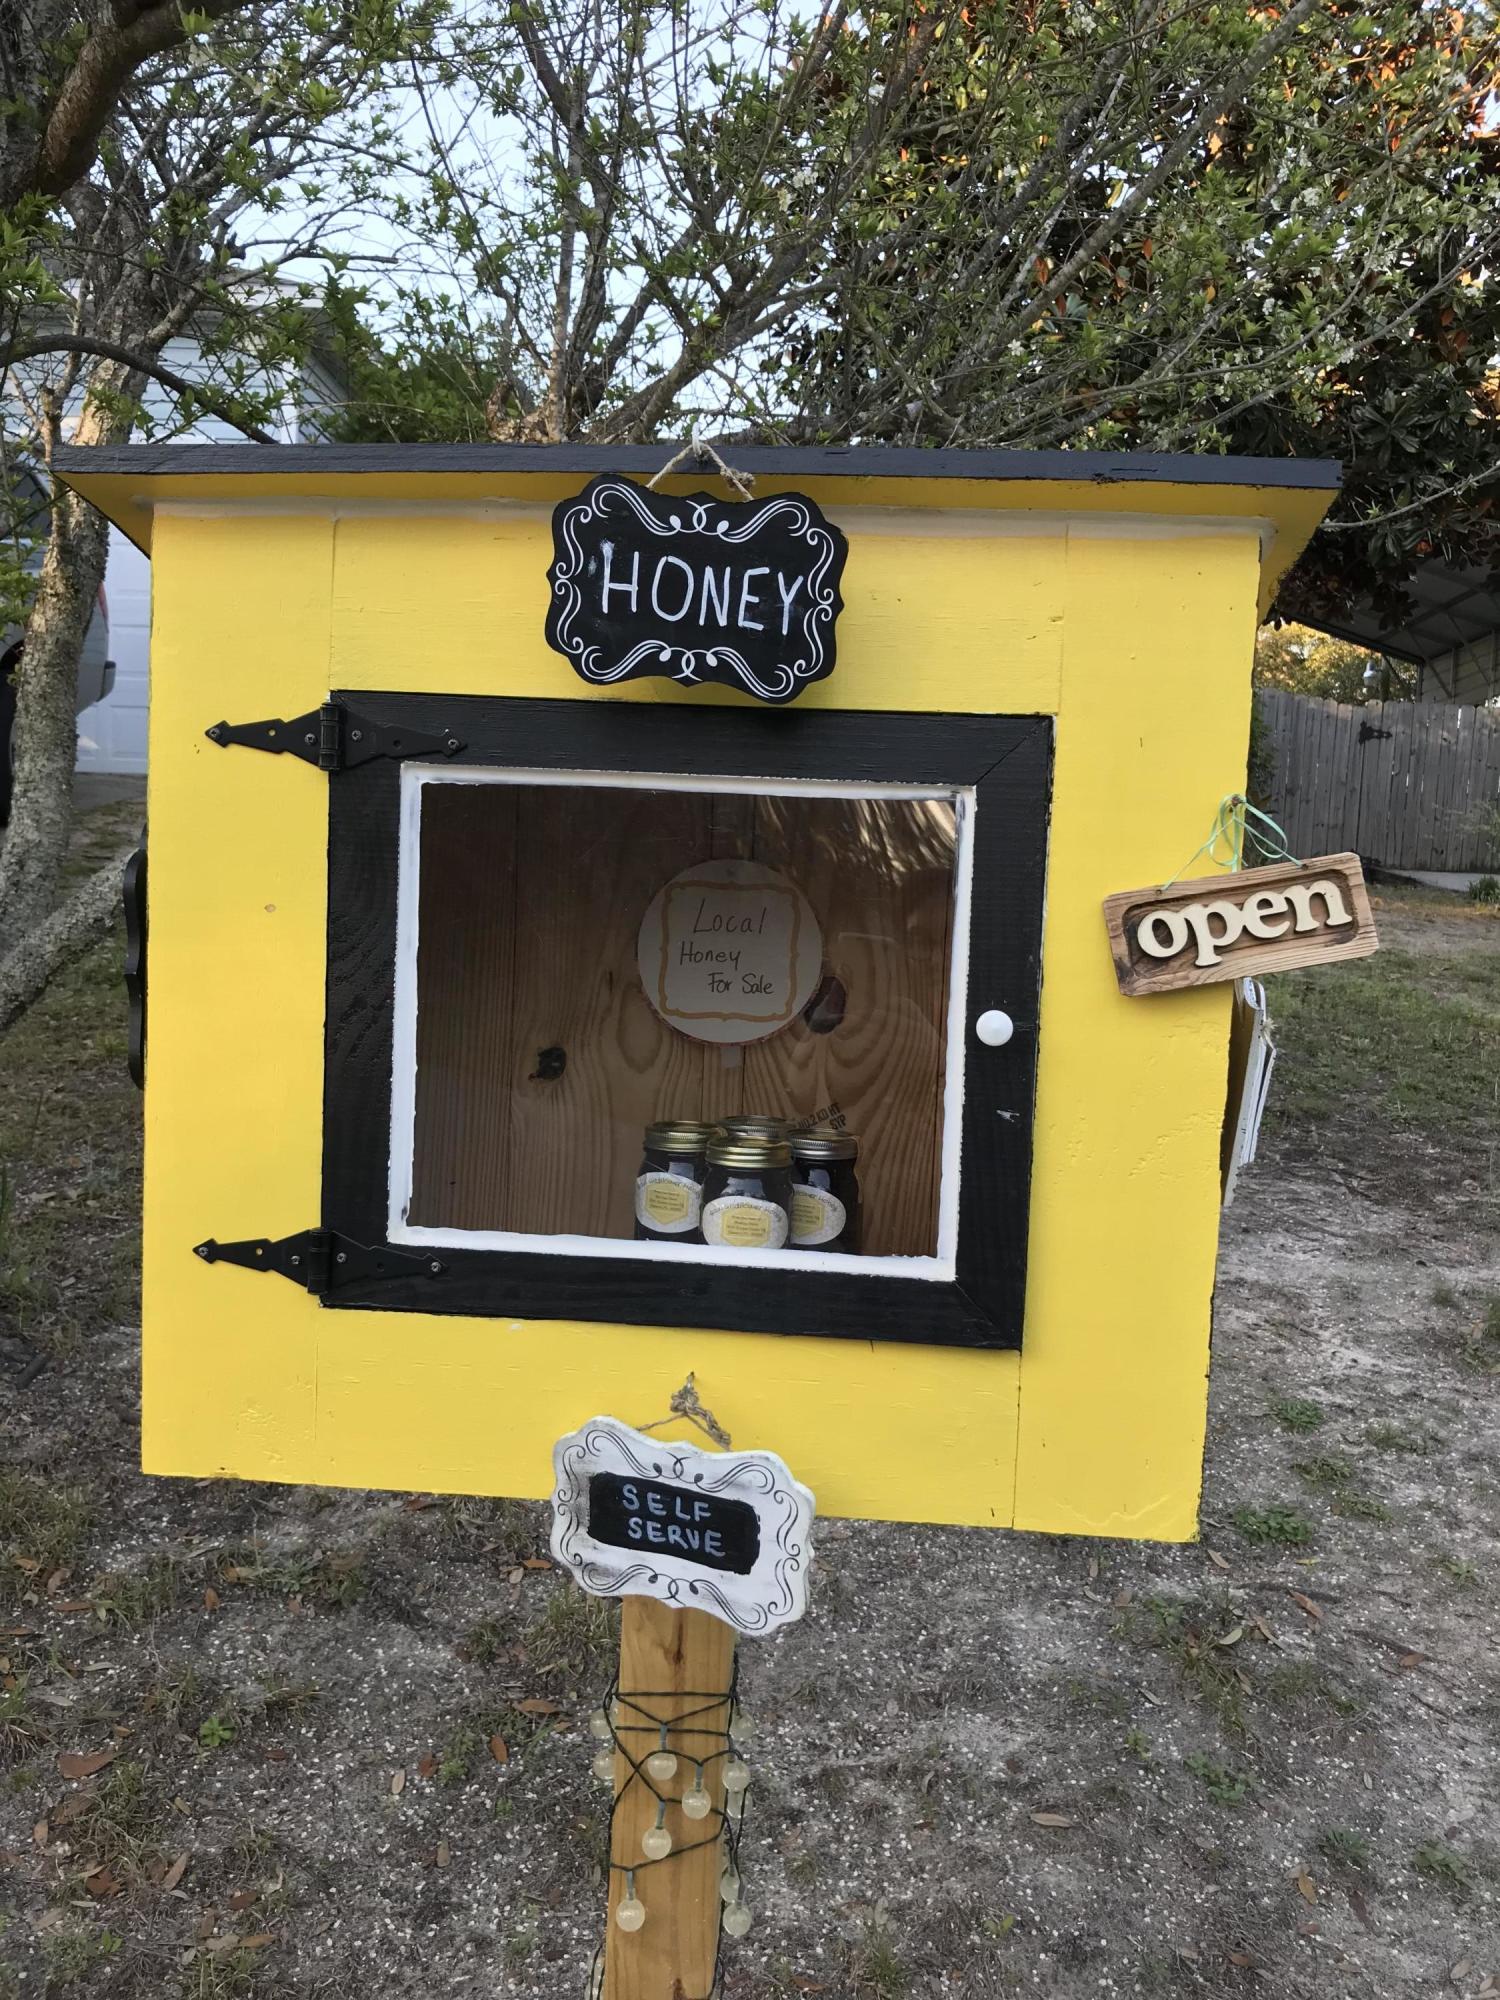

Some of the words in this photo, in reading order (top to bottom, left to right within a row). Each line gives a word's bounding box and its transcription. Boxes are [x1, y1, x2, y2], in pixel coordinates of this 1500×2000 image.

[600, 539, 804, 636] HONEY
[692, 898, 767, 935] Local
[1137, 880, 1353, 967] open
[679, 941, 741, 971] Honey
[707, 972, 732, 993] For
[741, 972, 775, 995] Sale
[622, 1483, 711, 1521] SELF
[627, 1516, 726, 1557] SERVE
